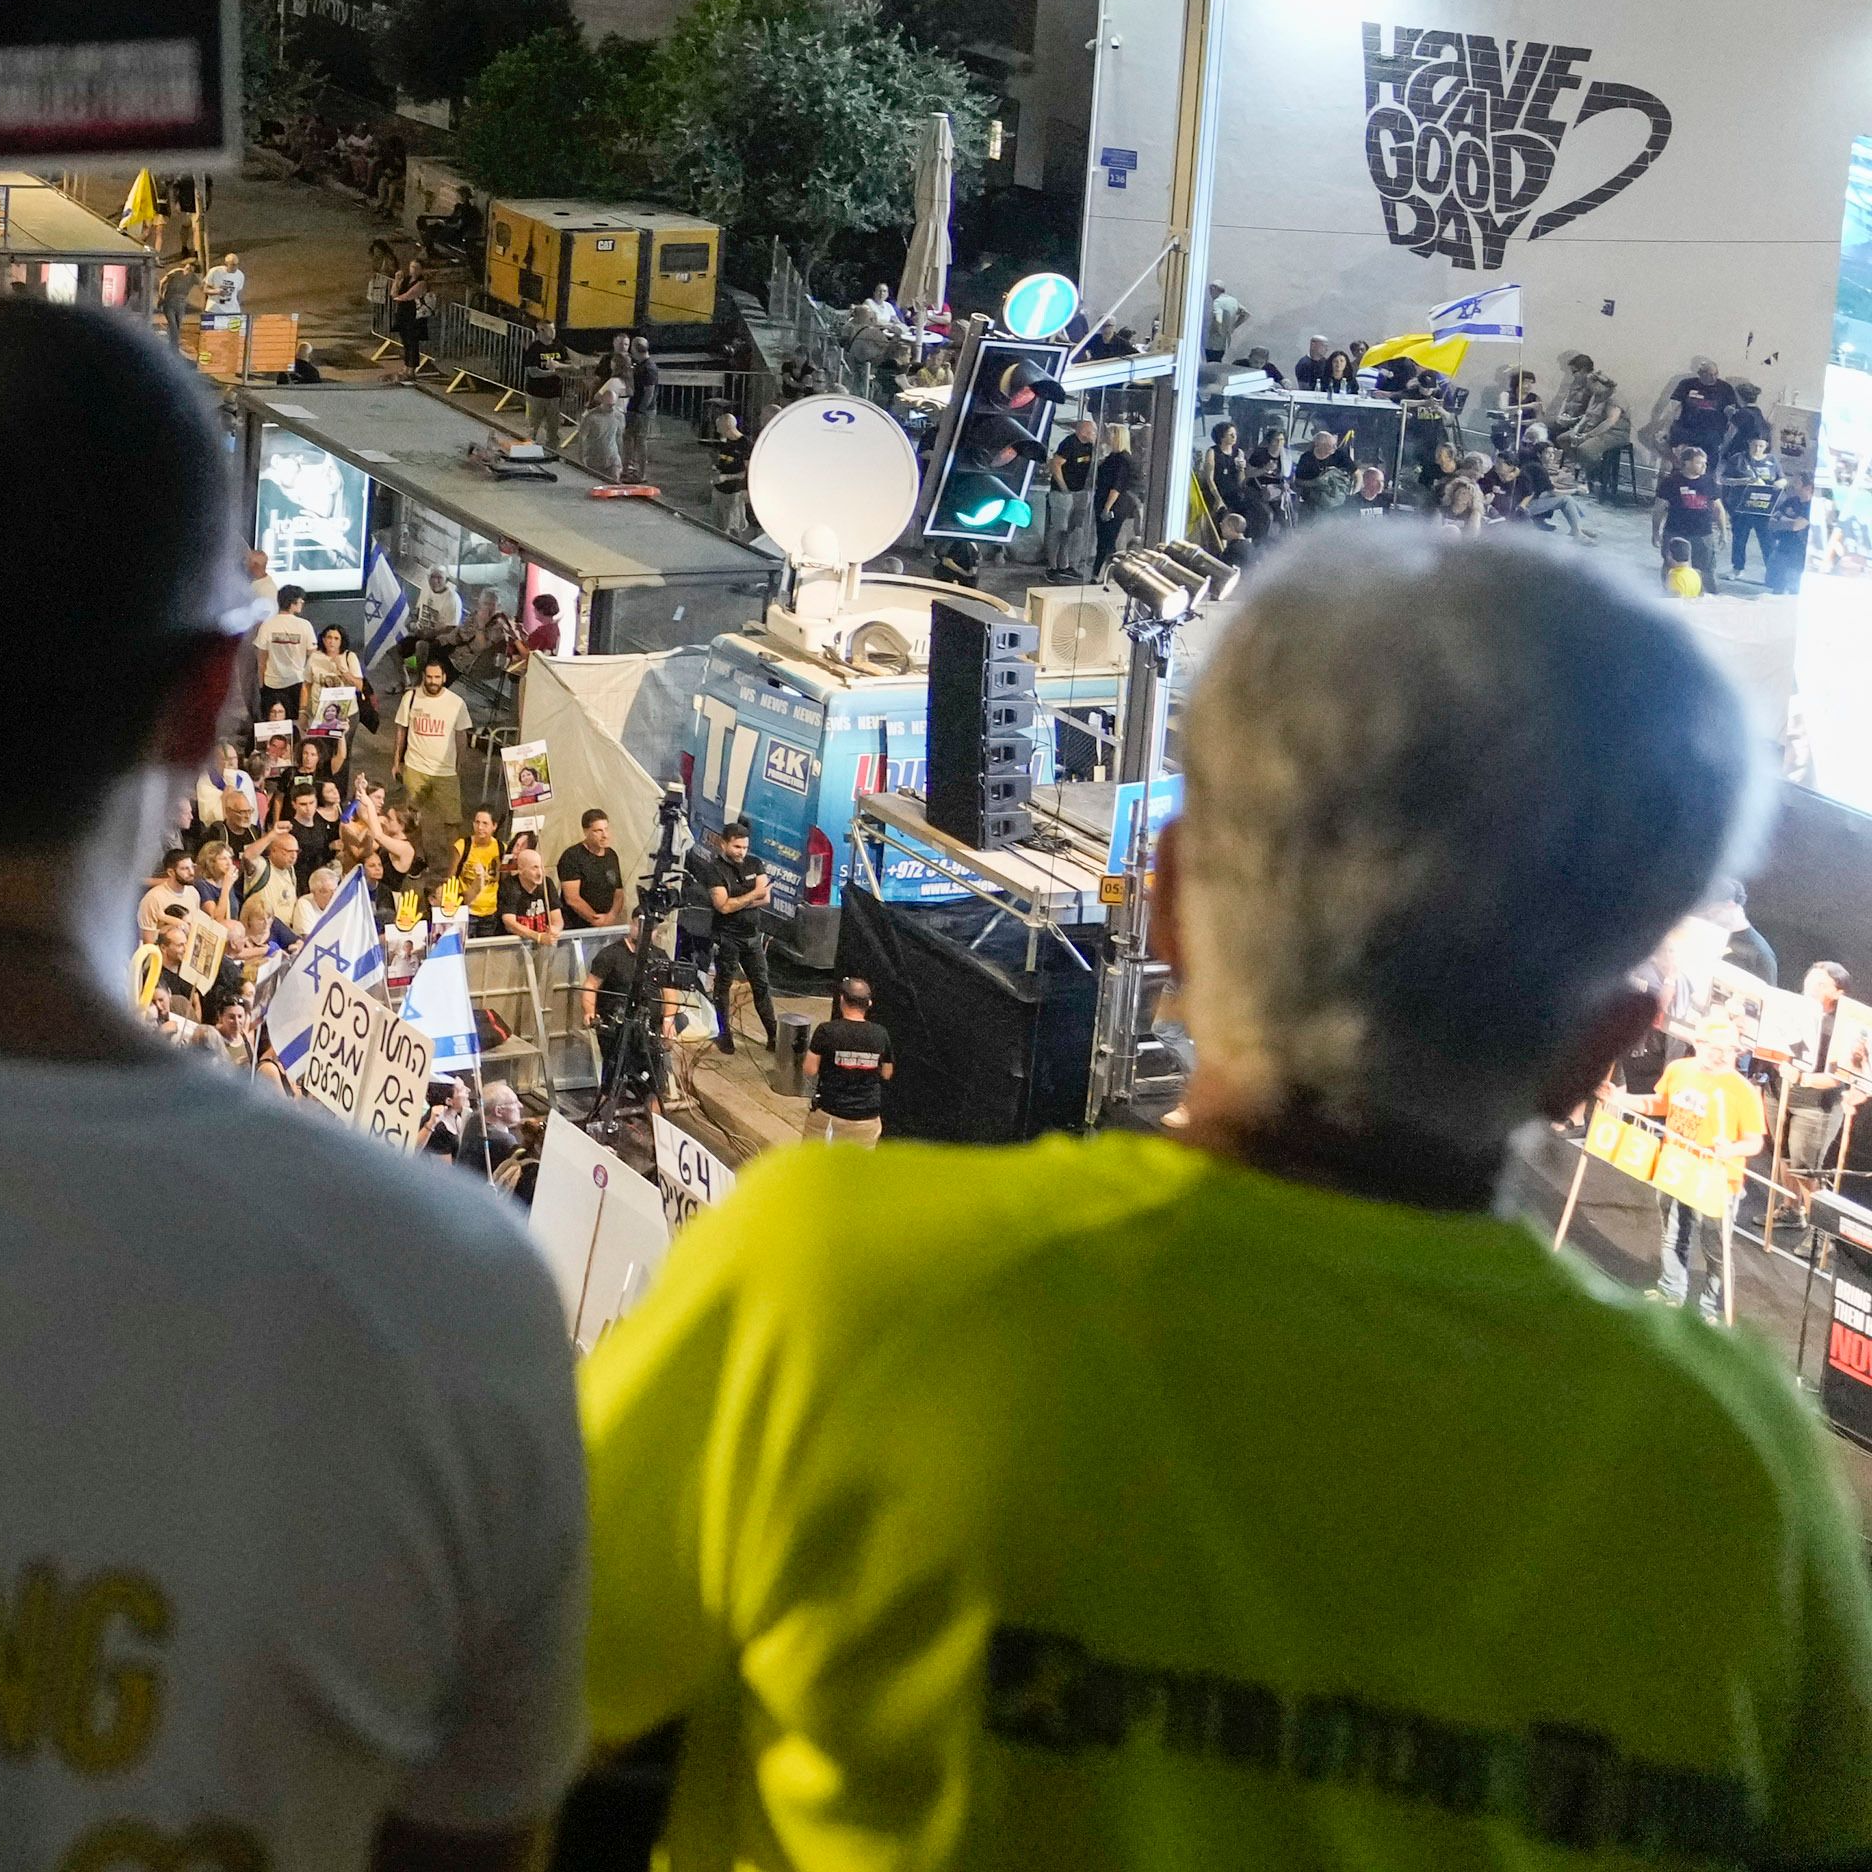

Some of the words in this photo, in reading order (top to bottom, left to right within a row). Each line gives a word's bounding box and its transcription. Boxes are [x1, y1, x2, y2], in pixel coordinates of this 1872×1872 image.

[1365, 106, 1561, 216] GOOD
[1379, 194, 1533, 271] DAY
[413, 716, 445, 734] NOW!
[759, 694, 790, 717] NEWS
[768, 745, 808, 780] 4K
[678, 1139, 712, 1203] 64
